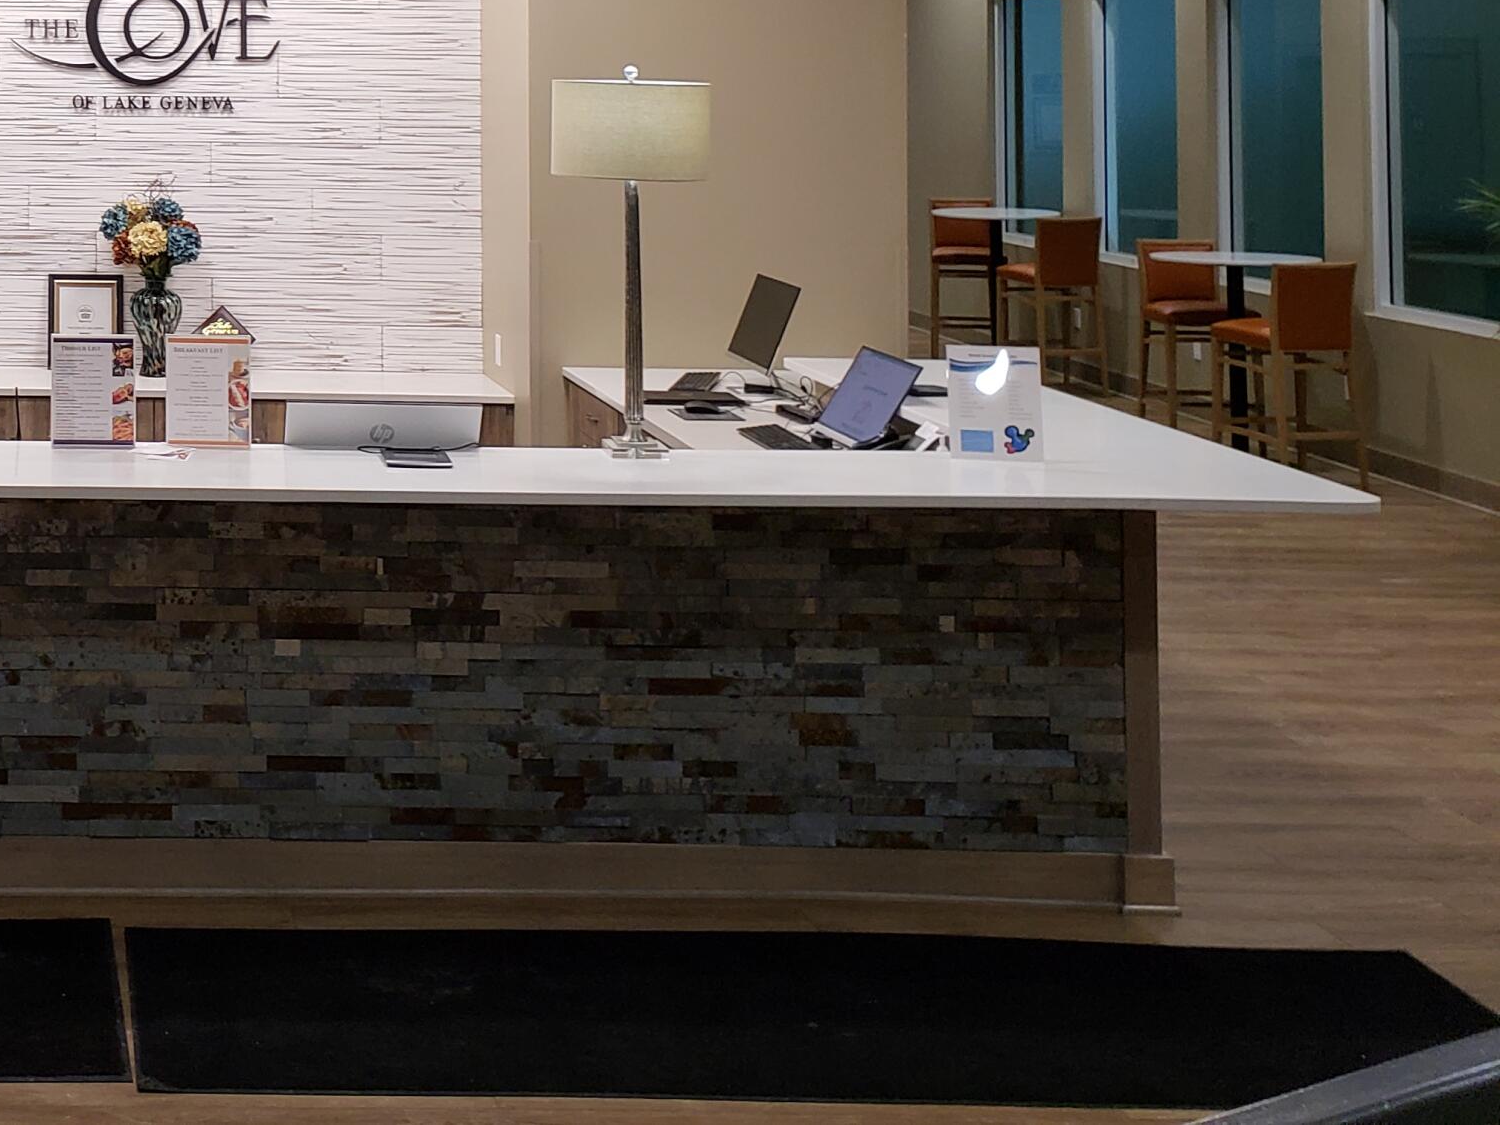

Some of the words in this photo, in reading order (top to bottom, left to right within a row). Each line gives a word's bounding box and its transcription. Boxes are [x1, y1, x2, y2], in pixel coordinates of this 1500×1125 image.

[24, 18, 79, 39] THE
[72, 94, 94, 110] OF
[102, 95, 150, 110] LAKE
[160, 95, 234, 110] GENEVA
